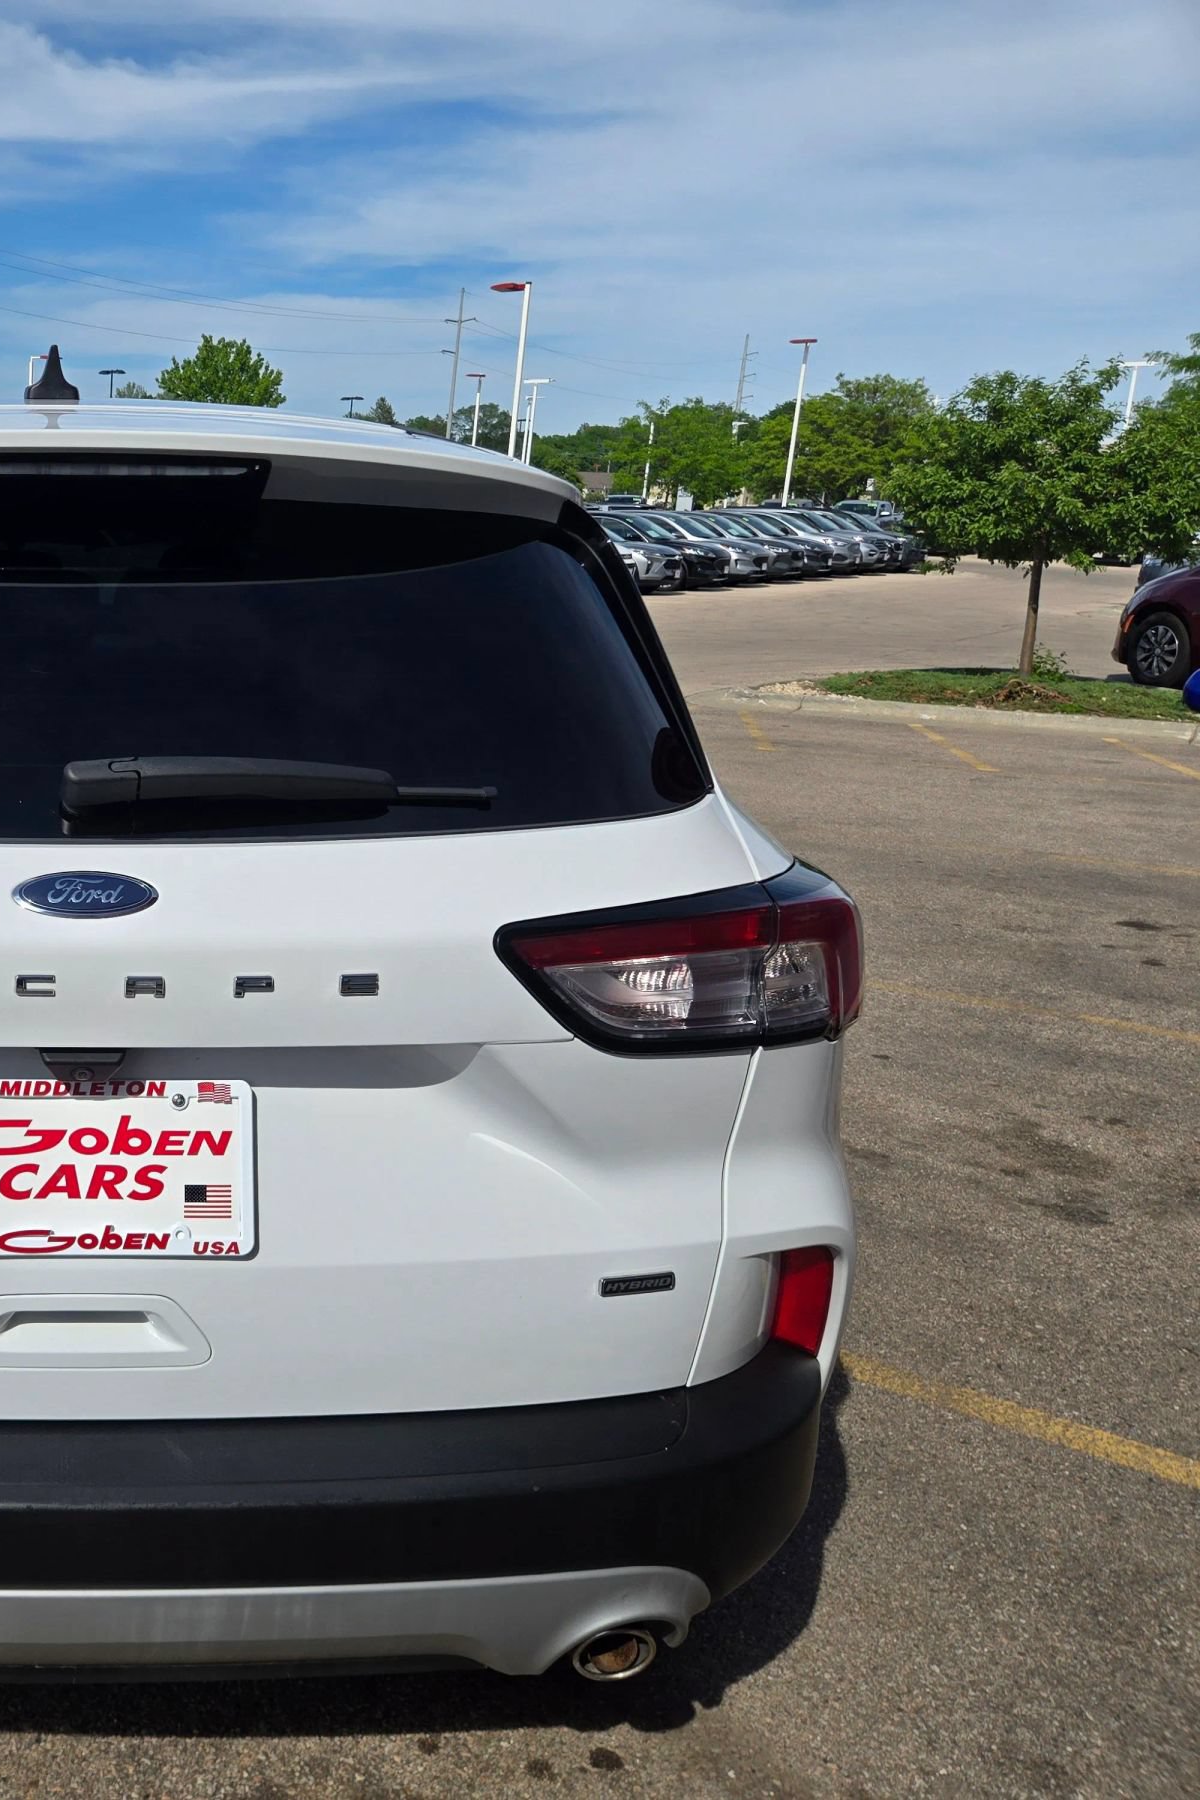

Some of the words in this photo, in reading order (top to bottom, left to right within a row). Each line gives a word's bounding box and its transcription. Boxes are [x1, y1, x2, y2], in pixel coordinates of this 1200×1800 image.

[47, 877, 124, 904] Ford
[0, 1079, 167, 1098] MIDDLETON
[193, 1241, 240, 1255] USA
[606, 1277, 671, 1292] HYBRID
